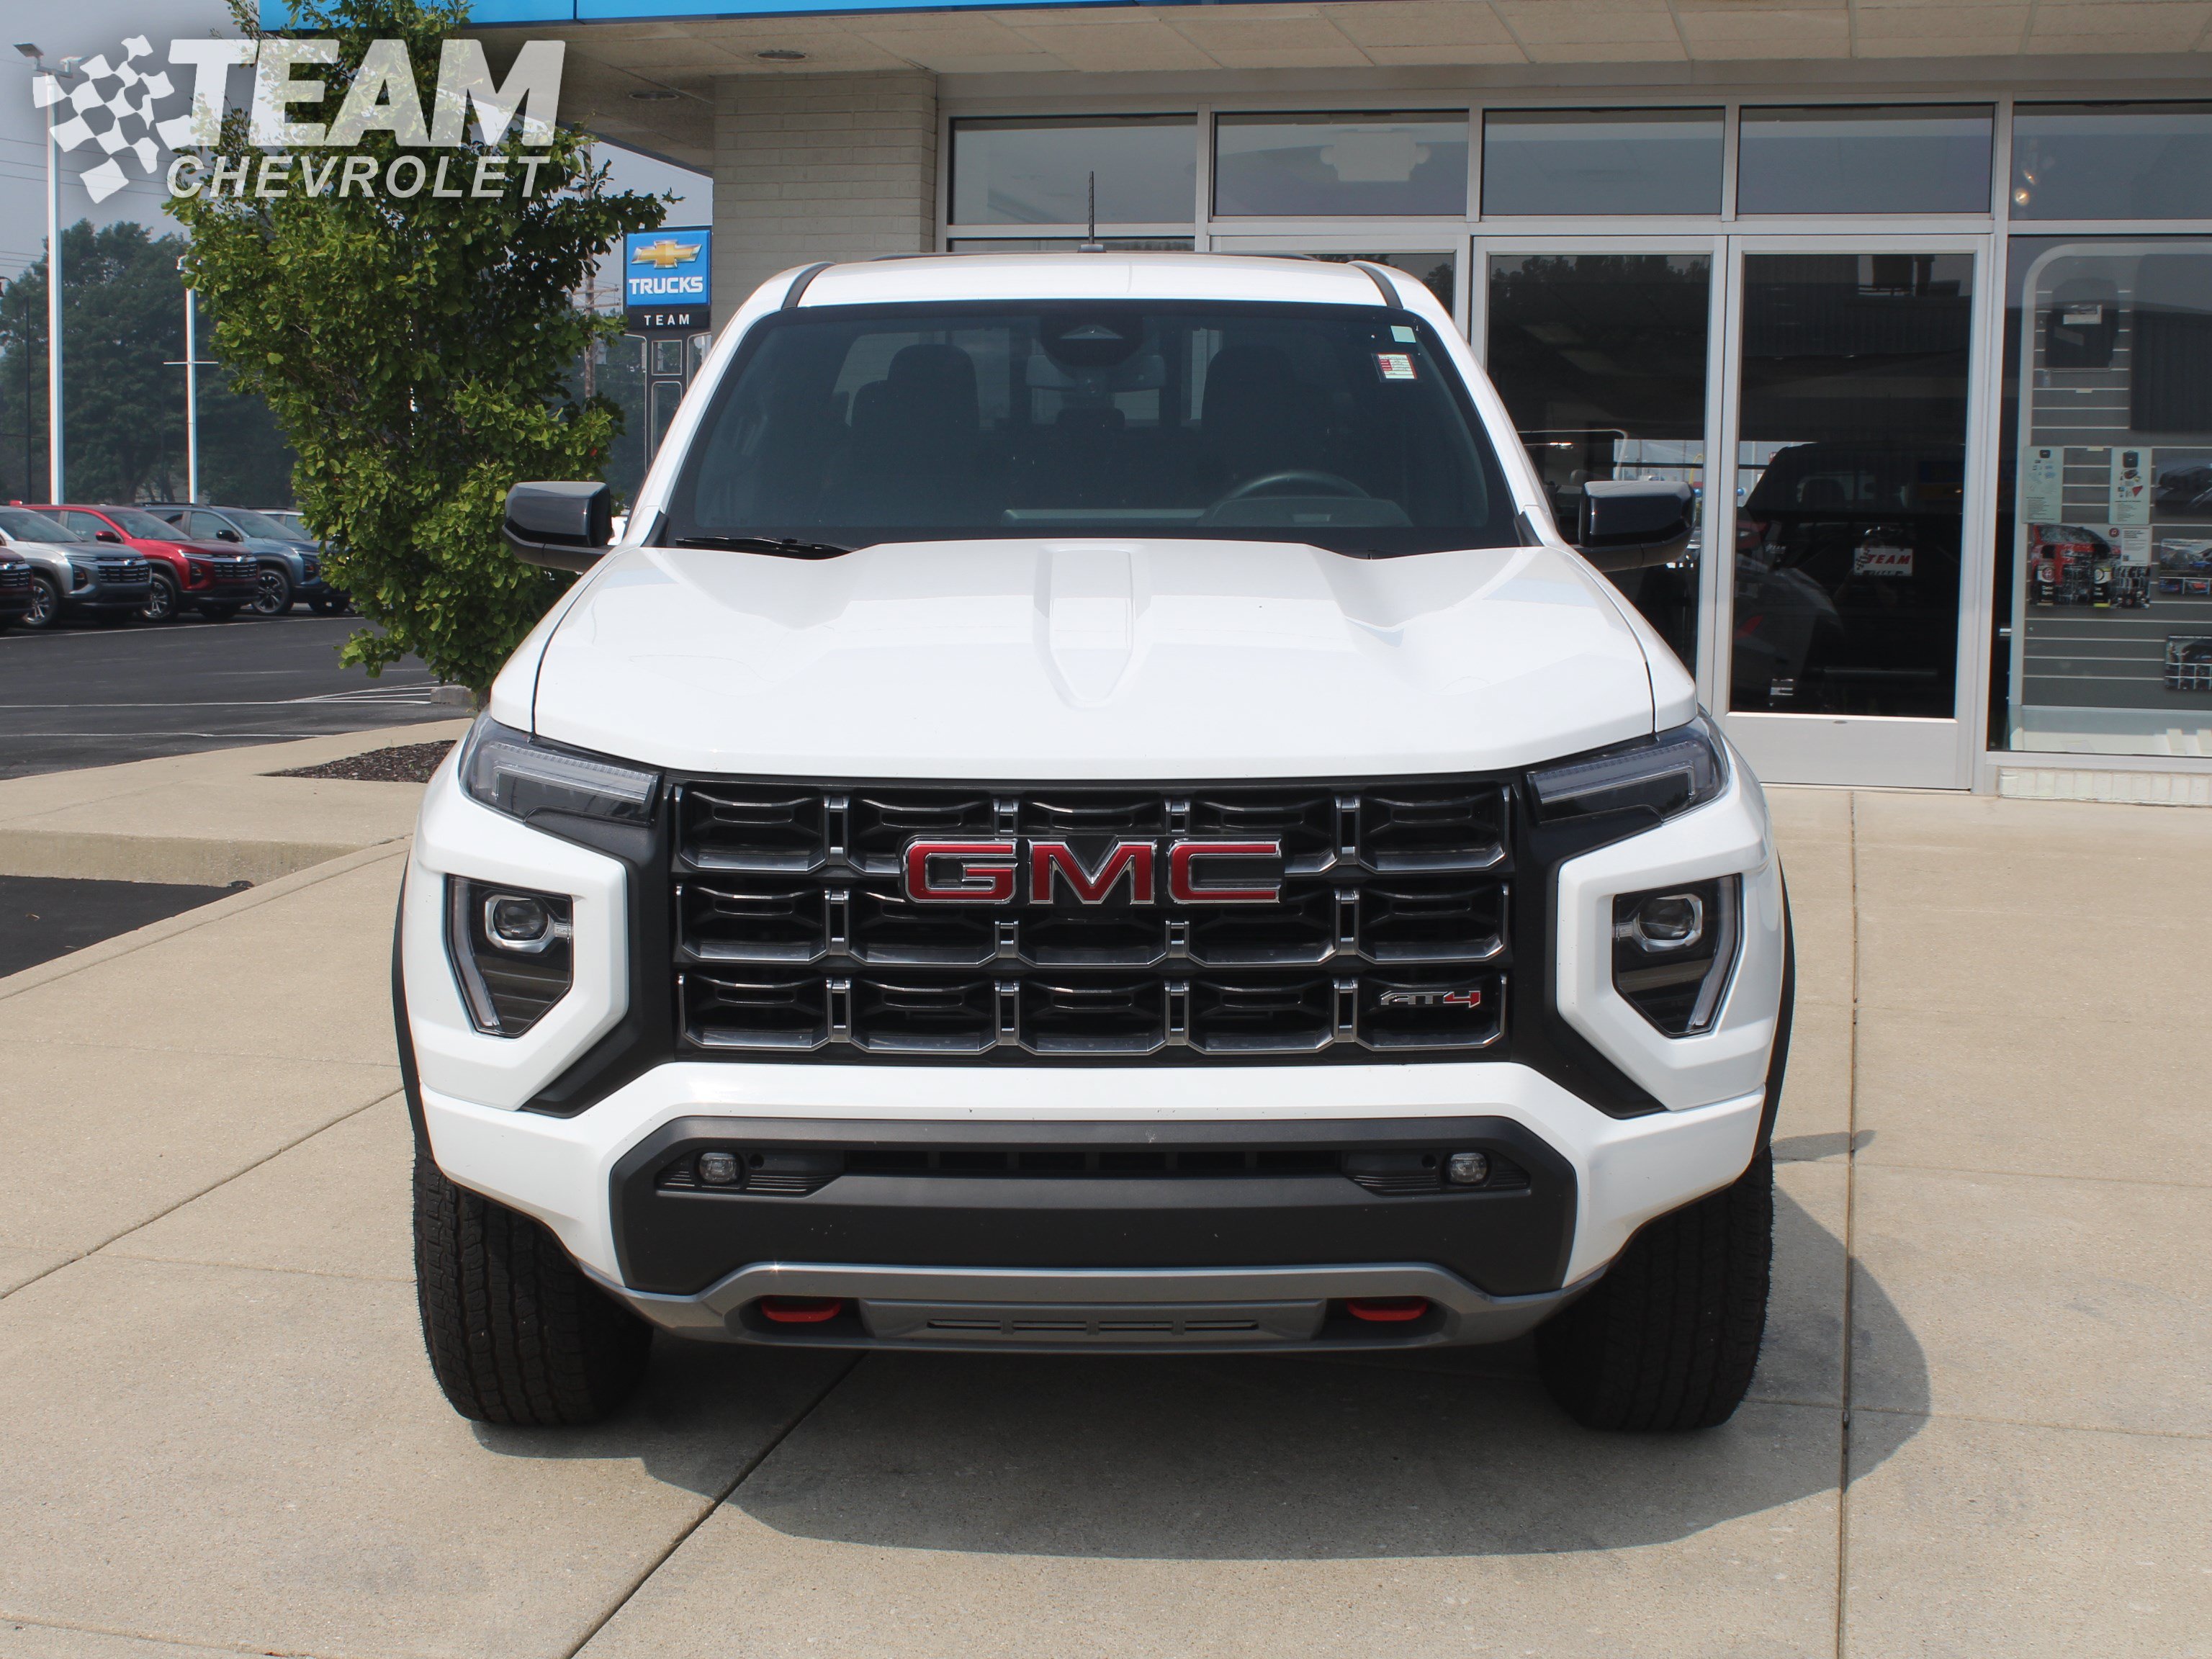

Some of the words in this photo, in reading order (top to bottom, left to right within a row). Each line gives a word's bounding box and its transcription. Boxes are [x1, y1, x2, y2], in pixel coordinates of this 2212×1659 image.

[629, 276, 703, 295] TRUCKS
[644, 313, 690, 325] TEAM
[1866, 554, 1911, 565] TEAM
[905, 838, 1282, 904] GMC
[1380, 990, 1480, 1008] AT4
